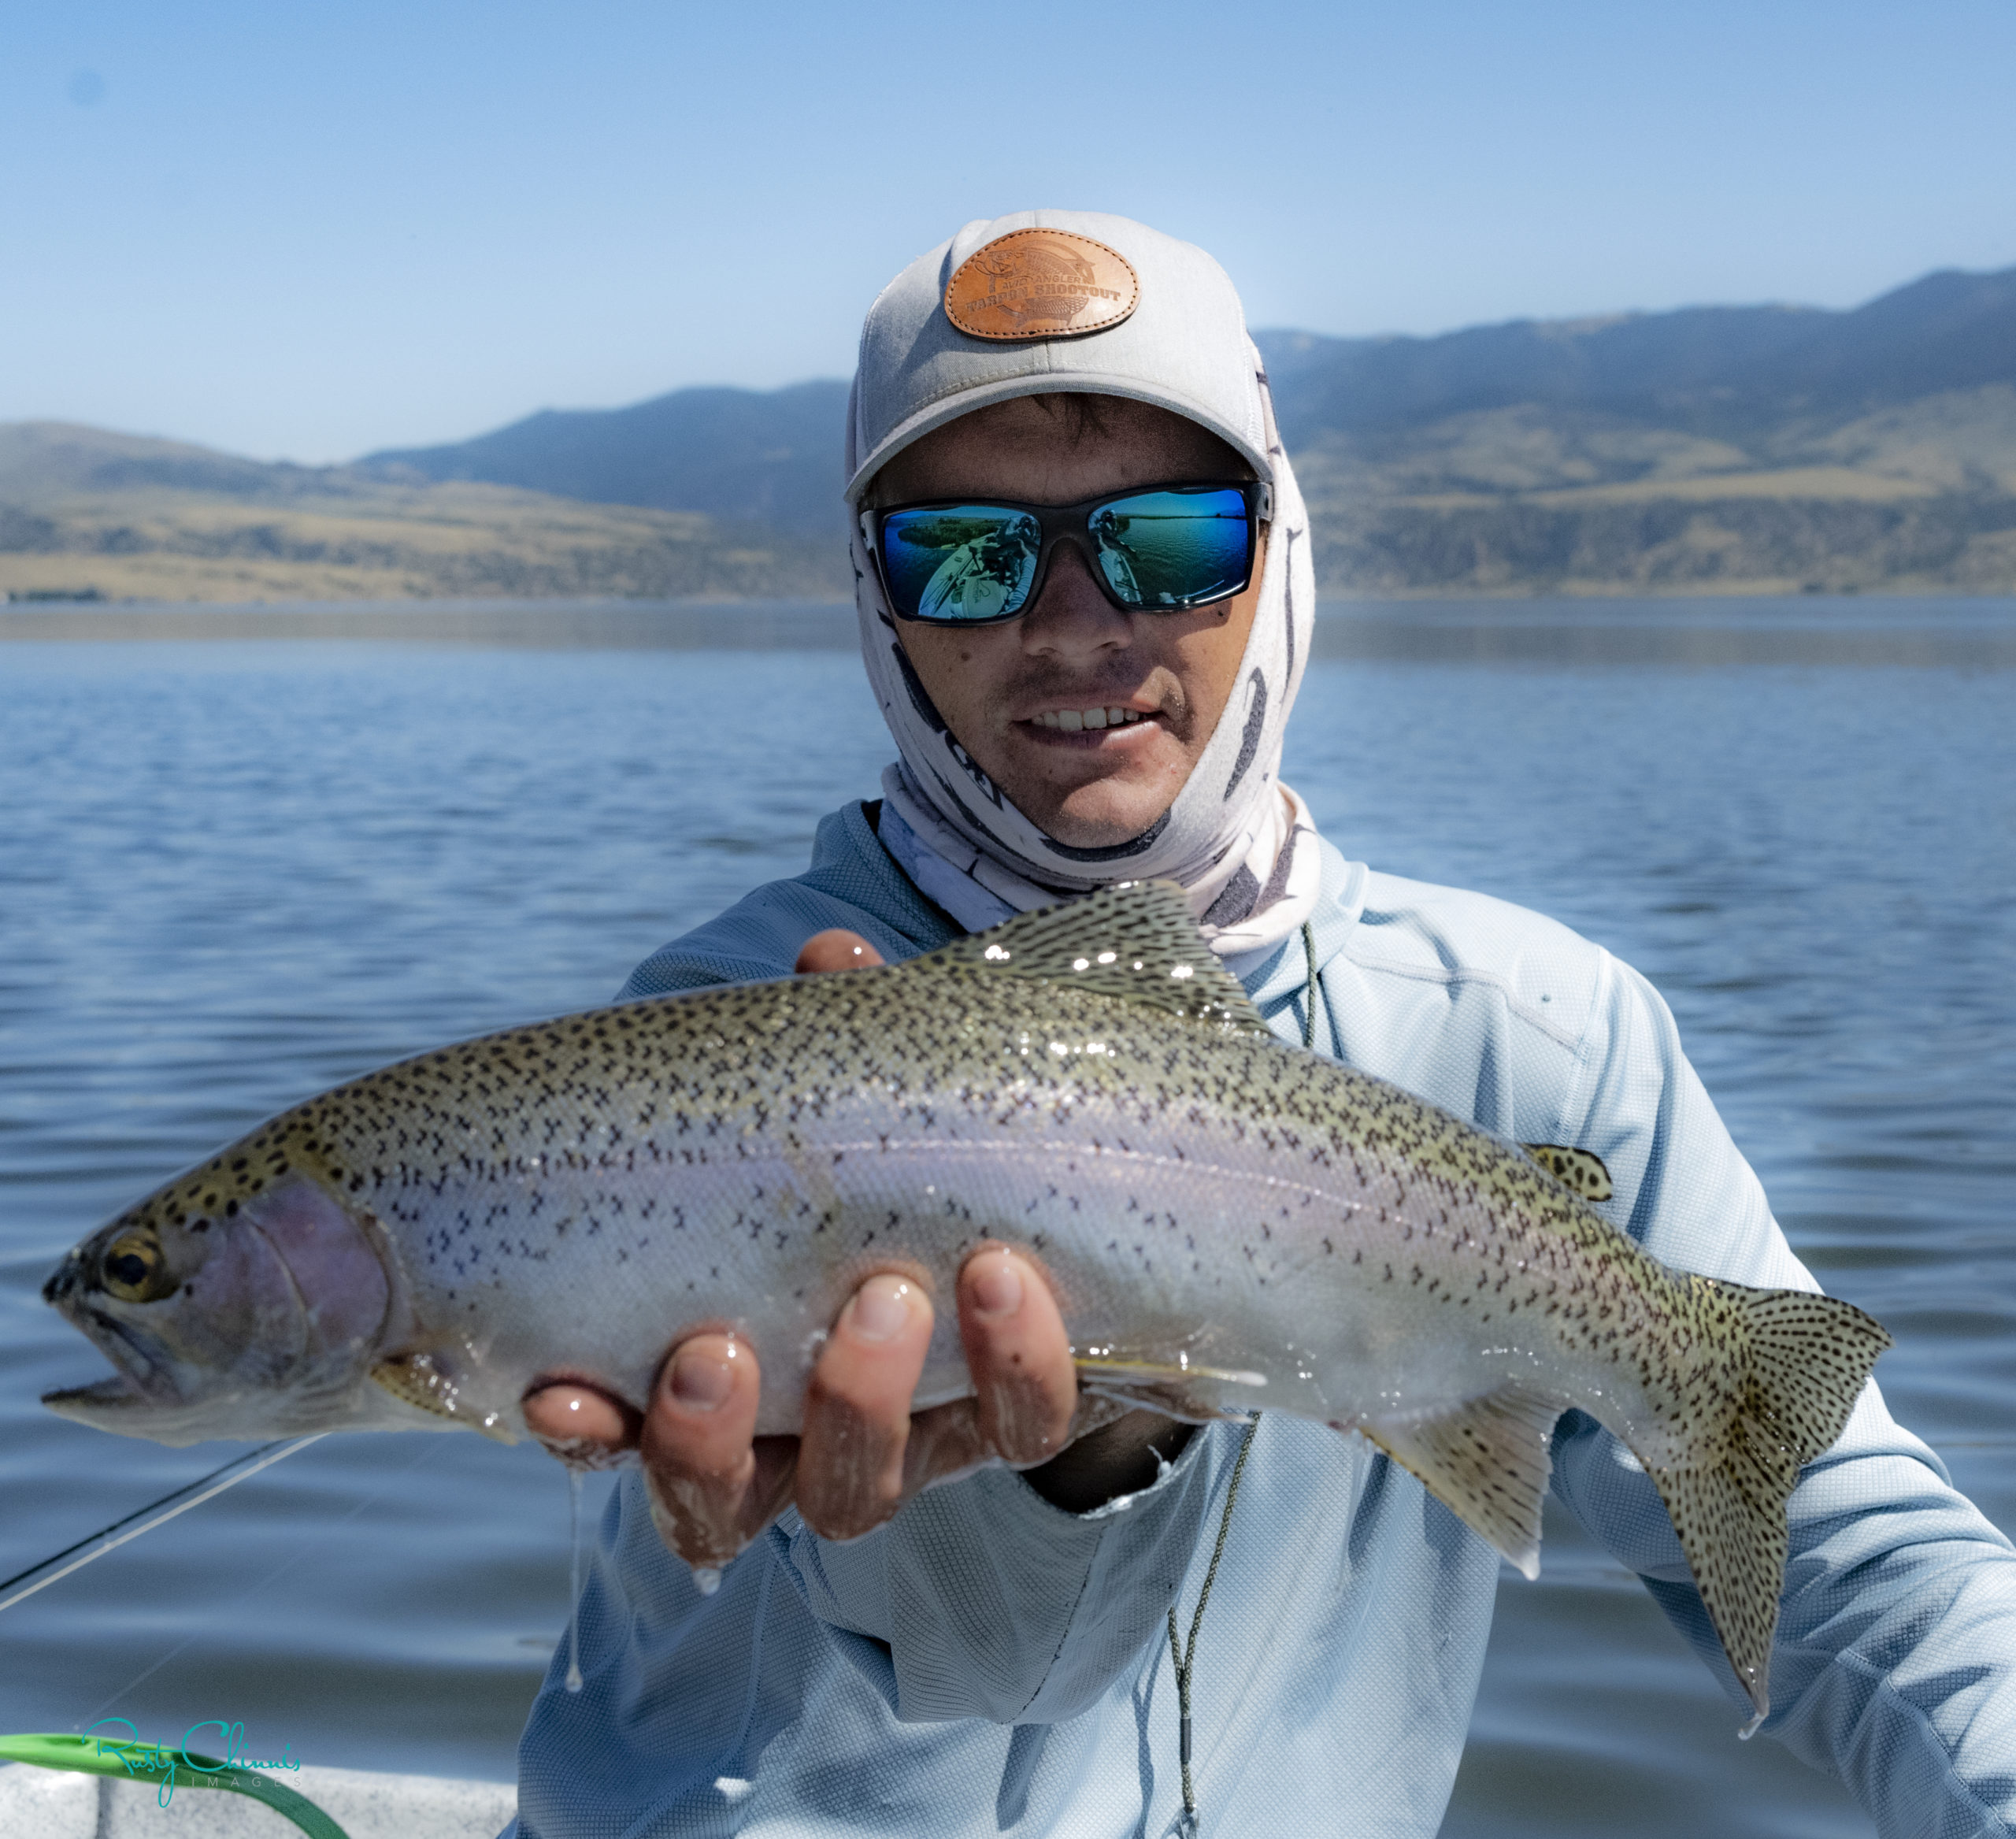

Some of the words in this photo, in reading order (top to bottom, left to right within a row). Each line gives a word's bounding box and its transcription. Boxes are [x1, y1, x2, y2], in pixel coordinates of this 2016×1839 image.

[1002, 277, 1028, 290] AVID
[1035, 274, 1081, 284] ANGLER
[965, 287, 1028, 313] TARPON
[1034, 282, 1121, 302] SHOOTOUT
